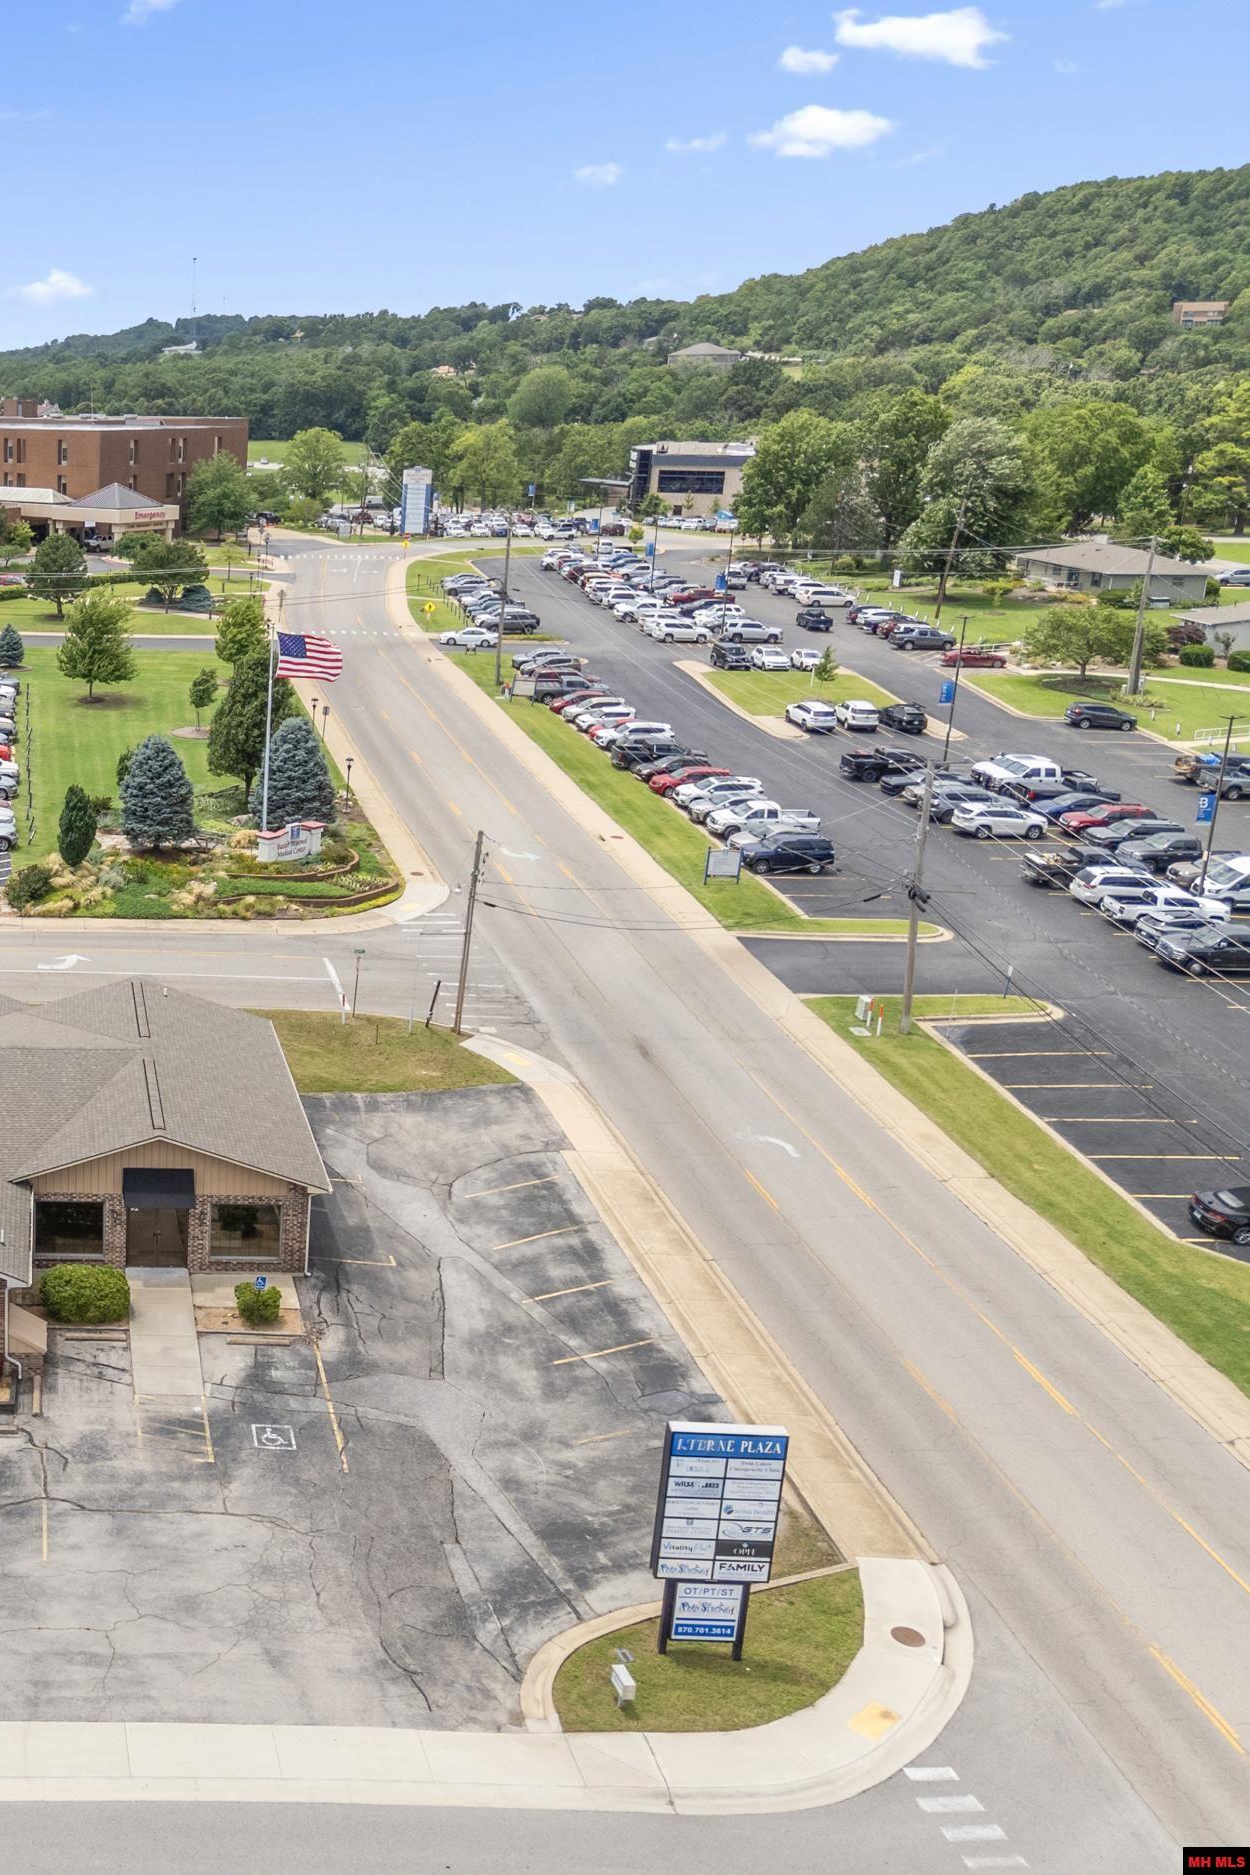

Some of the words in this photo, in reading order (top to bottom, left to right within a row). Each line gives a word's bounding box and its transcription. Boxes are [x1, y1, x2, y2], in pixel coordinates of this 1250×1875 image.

[134, 511, 166, 520] Emergency
[740, 1440, 782, 1454] PLAZA
[742, 1526, 773, 1534] GTS
[663, 1541, 693, 1552] Vitality
[719, 1562, 766, 1572] FAMILY
[684, 1587, 735, 1597] OT/PT/ST
[678, 1626, 731, 1635] 870.701.3614
